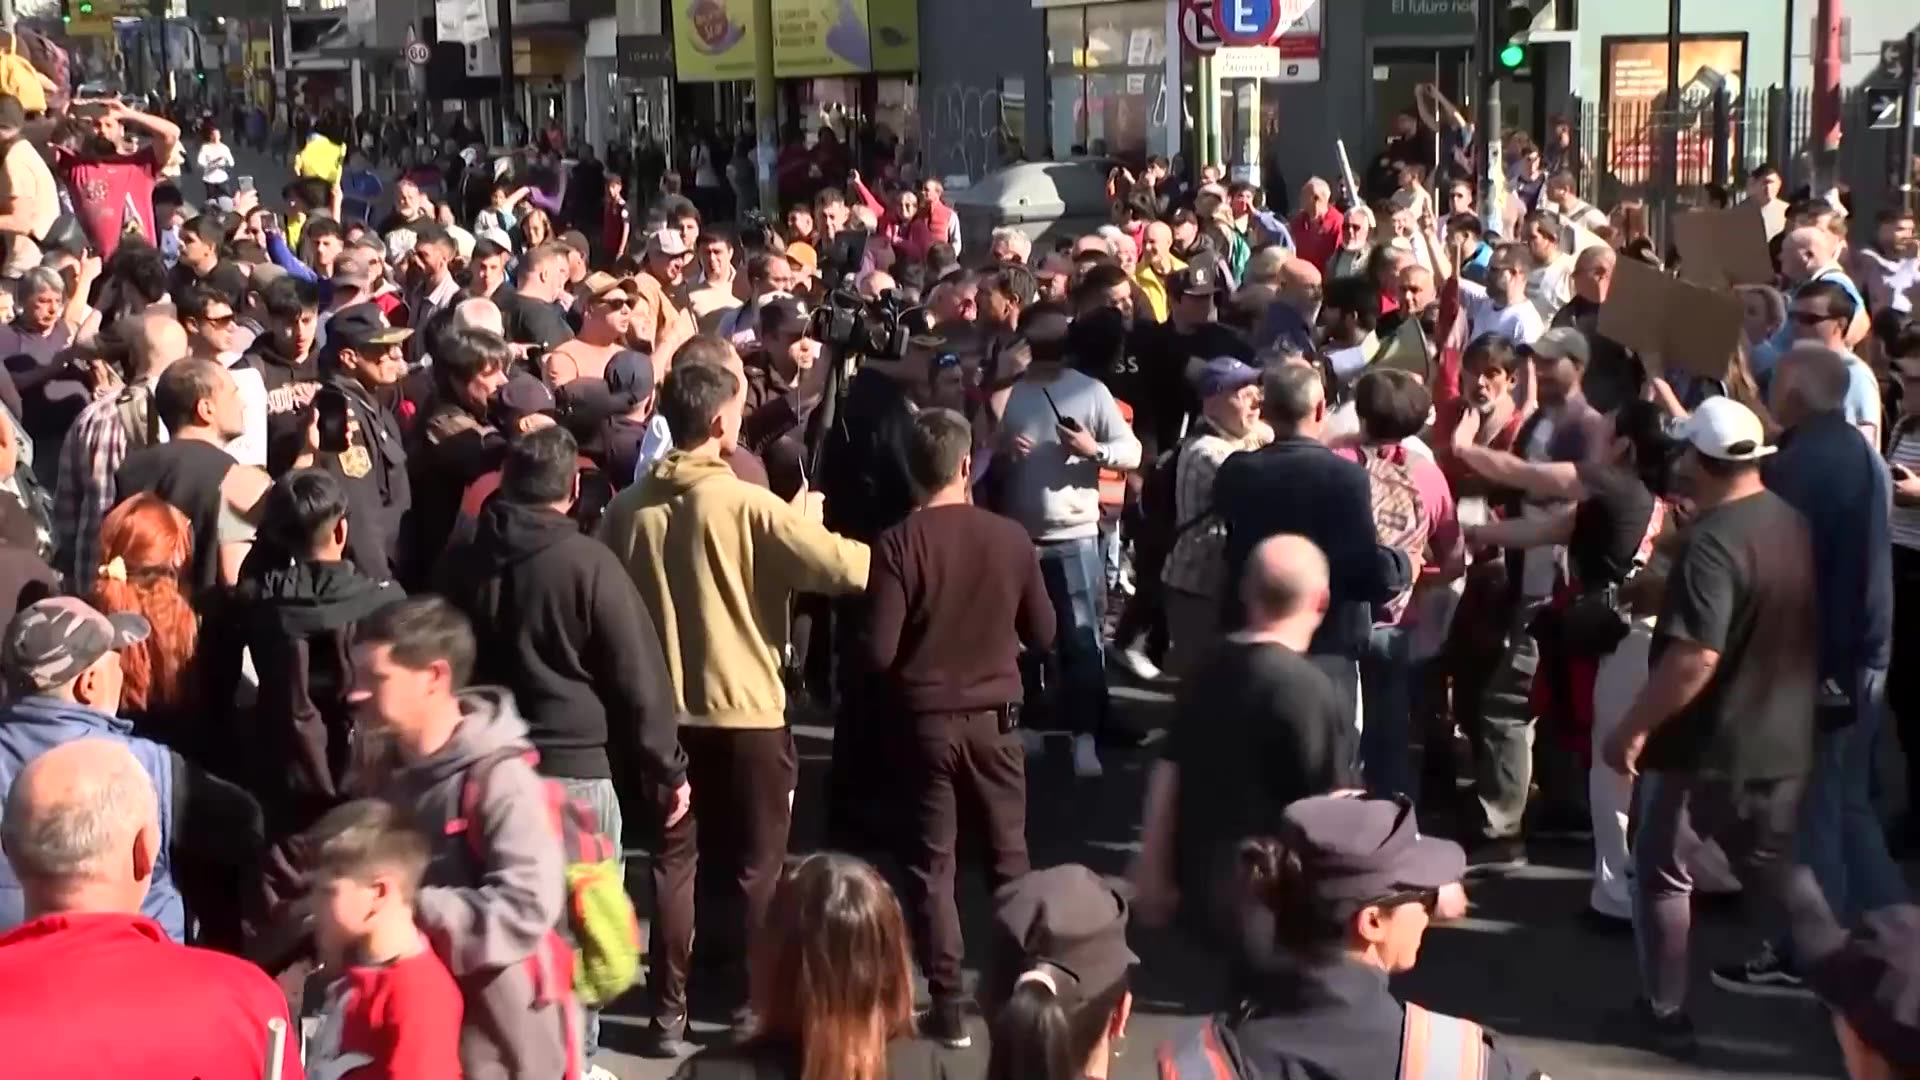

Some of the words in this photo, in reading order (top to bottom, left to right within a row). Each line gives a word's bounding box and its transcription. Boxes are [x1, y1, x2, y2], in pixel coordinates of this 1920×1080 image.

[1408, 0, 1448, 14] futuro
[1233, 0, 1259, 32] E
[409, 46, 427, 60] 60
